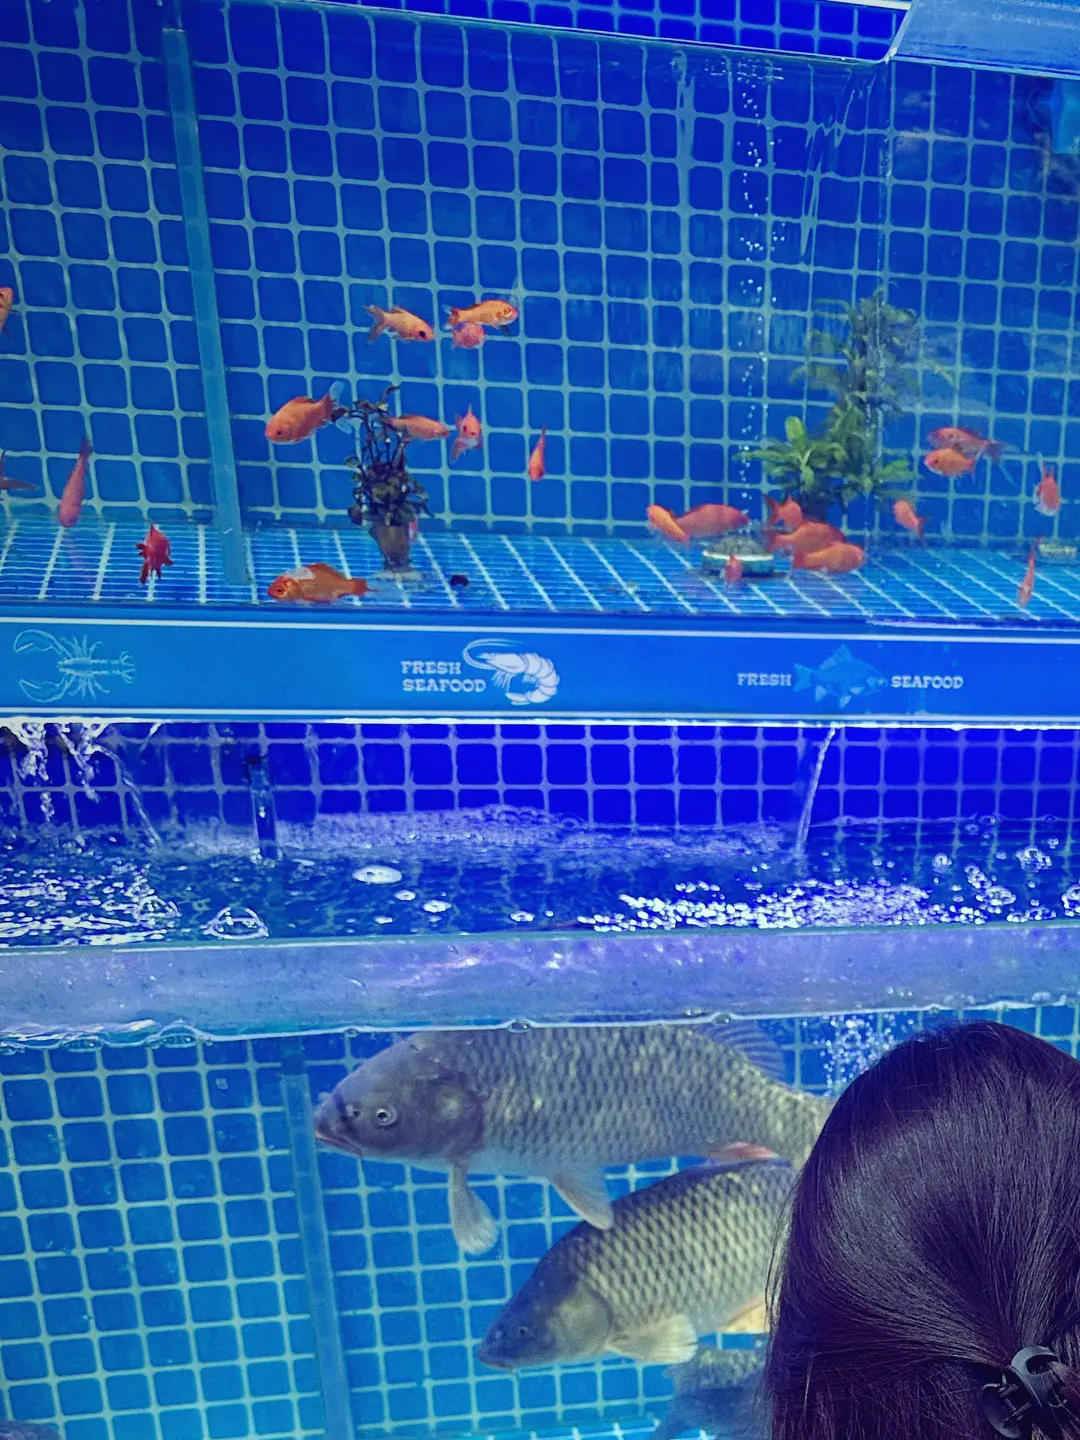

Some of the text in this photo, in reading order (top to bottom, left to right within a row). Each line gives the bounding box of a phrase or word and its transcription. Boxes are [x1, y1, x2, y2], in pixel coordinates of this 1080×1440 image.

[401, 661, 462, 675] FRESH
[403, 678, 486, 692] SEAFOOD
[737, 672, 964, 689] FRESH SEAFOOD
